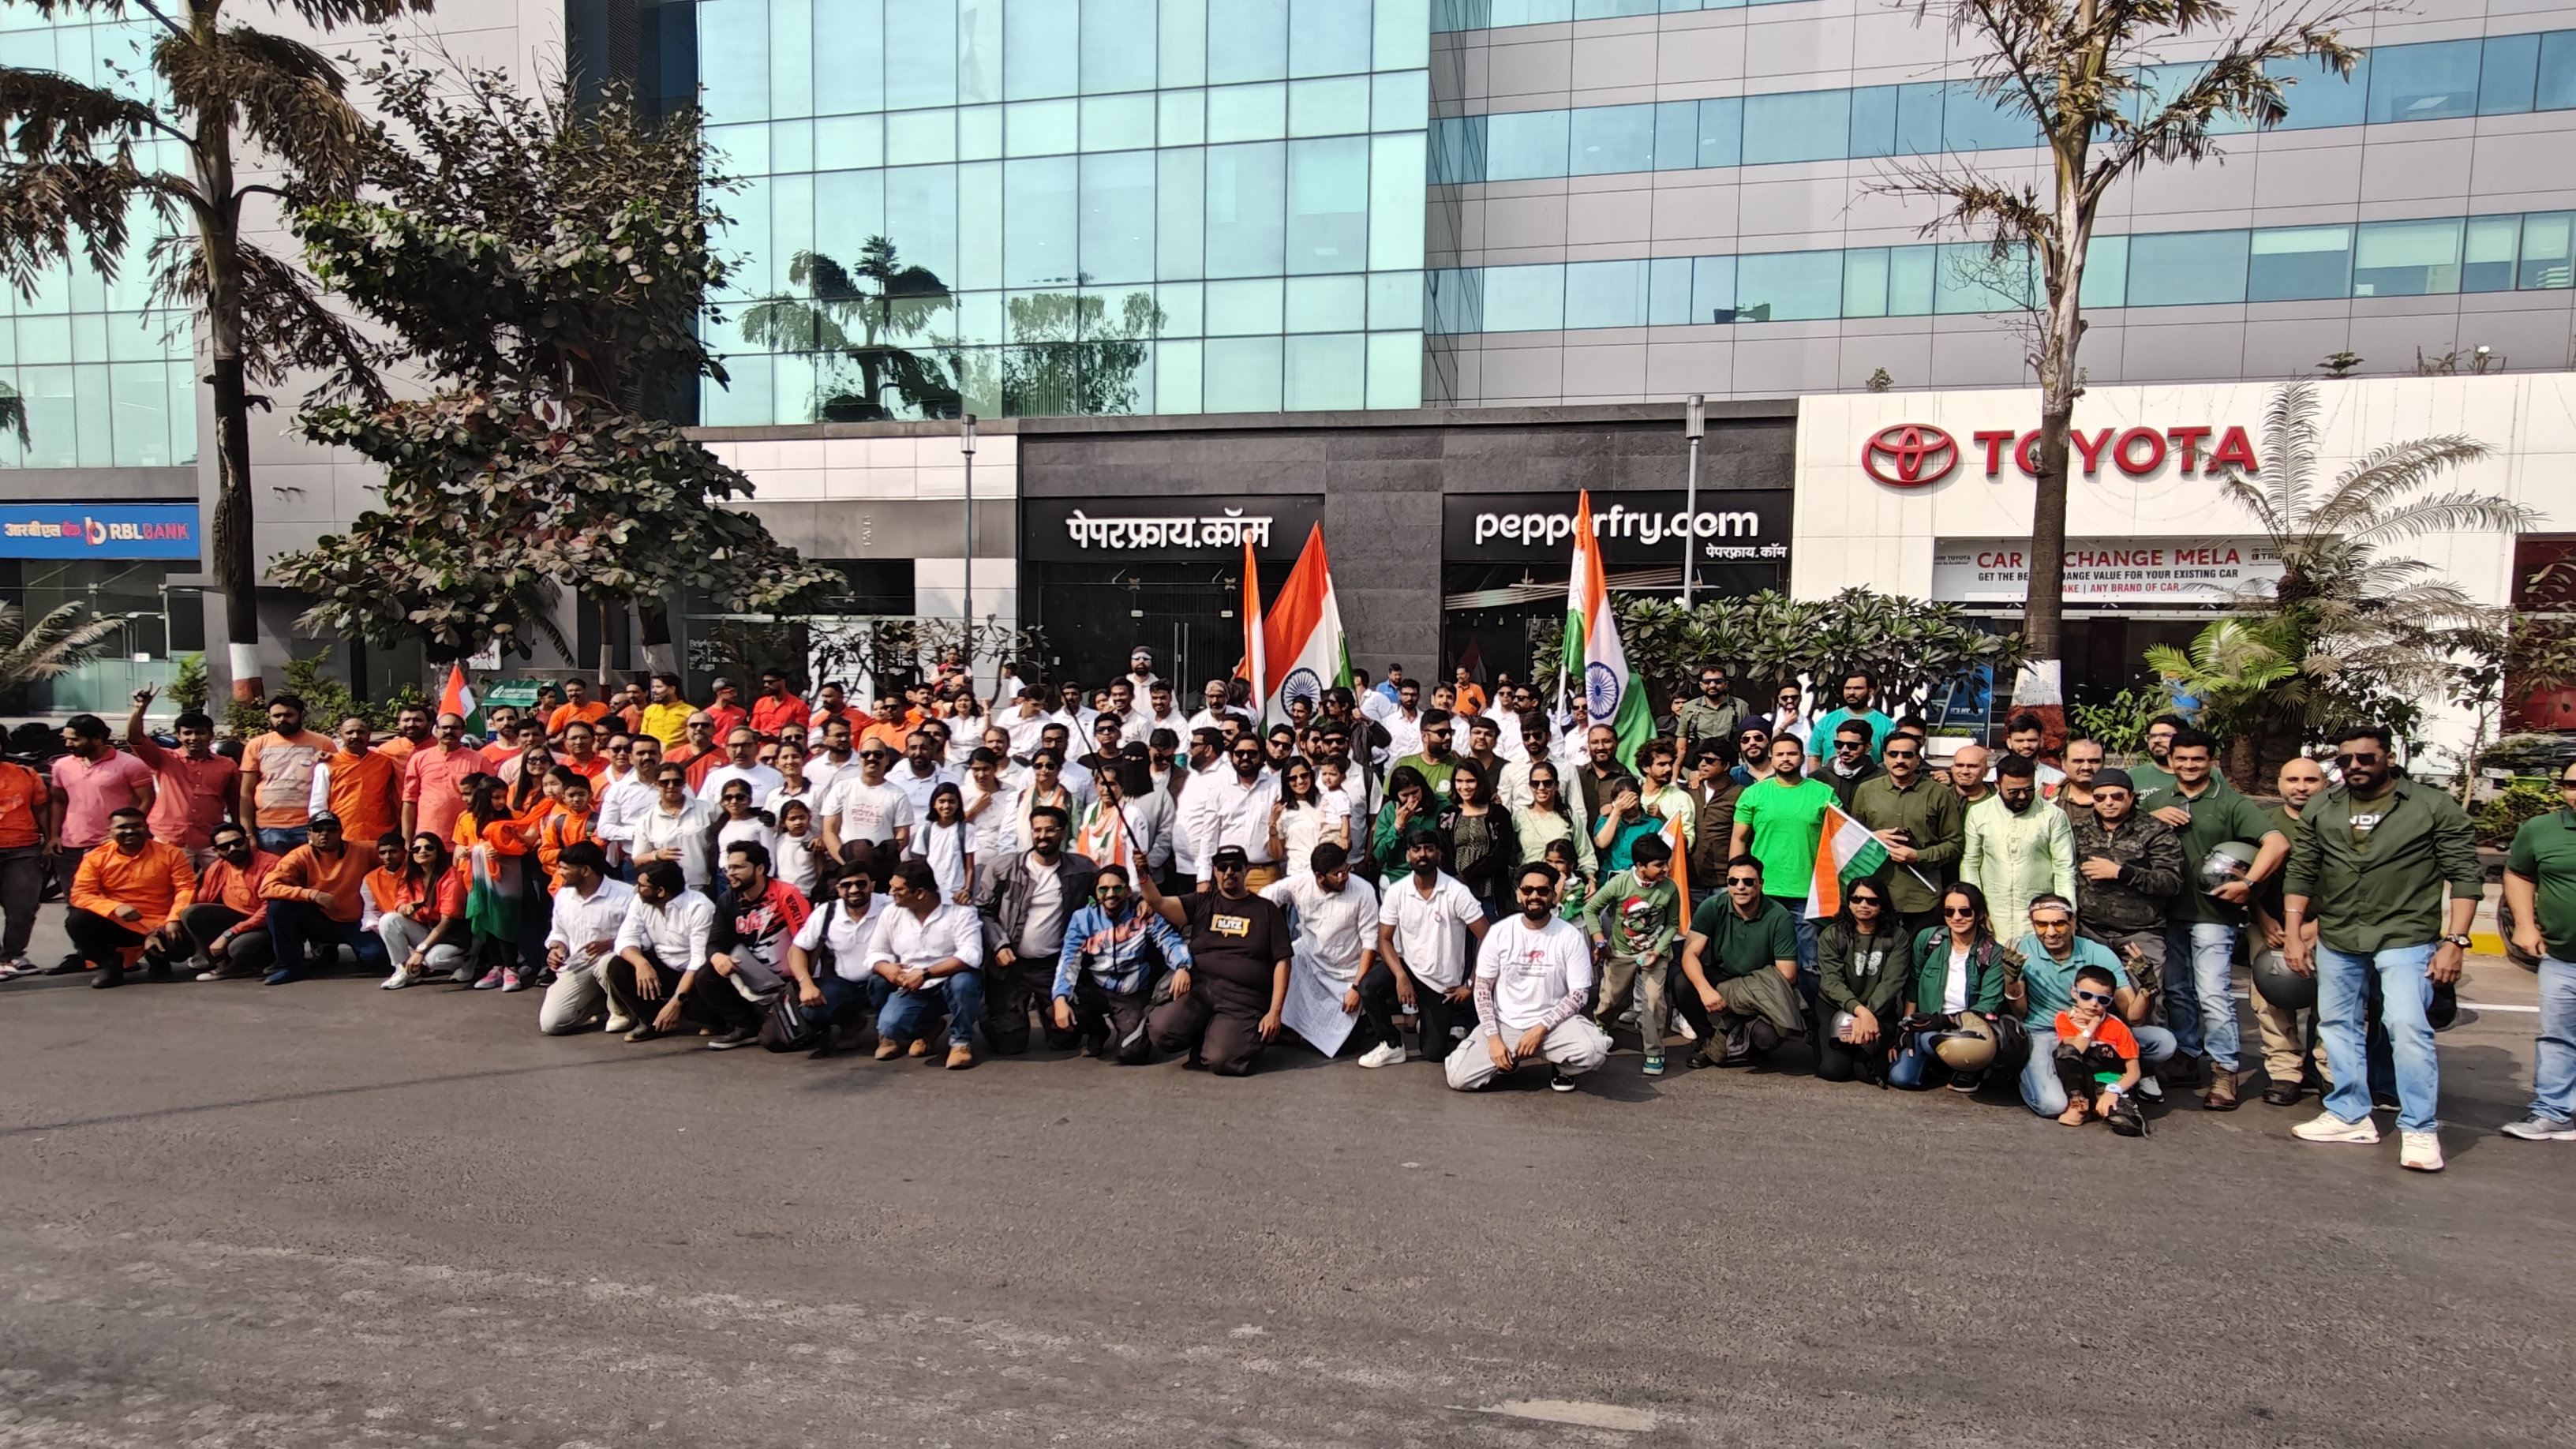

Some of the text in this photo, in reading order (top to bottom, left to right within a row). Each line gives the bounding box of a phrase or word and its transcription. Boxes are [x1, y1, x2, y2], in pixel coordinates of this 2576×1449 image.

[110, 523, 144, 540] RBL
[1977, 548, 2241, 568] CAR CHANGE MELA
[1978, 568, 2238, 582] GET THE BE ANGE VALUE FOR YOUR EXISTING CAR
[2062, 582, 2180, 593] AKE ANY BRAND OF CAR
[473, 650, 495, 660] ECH
[2349, 814, 2380, 826] NDI
